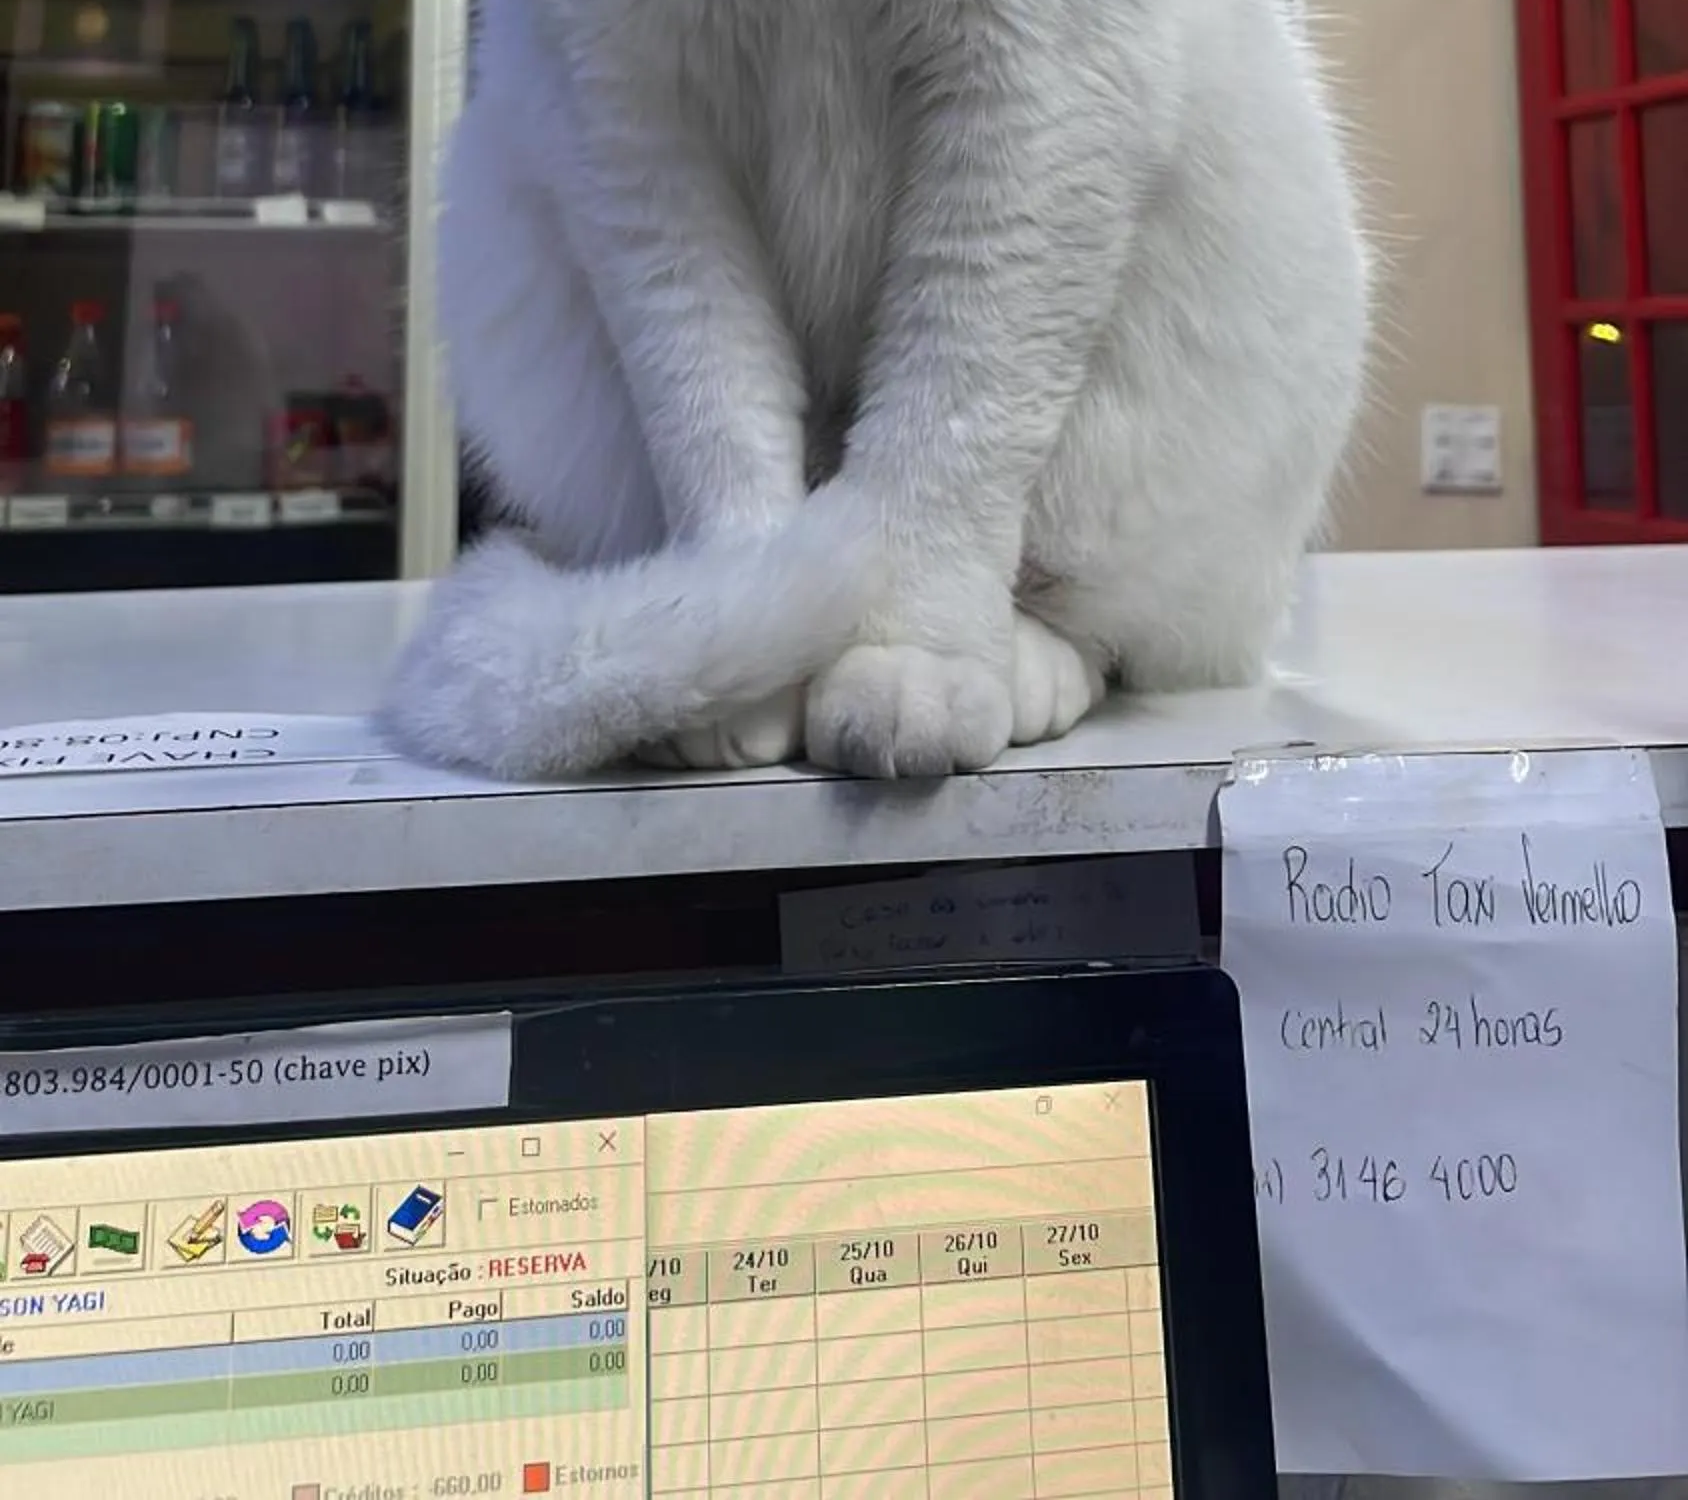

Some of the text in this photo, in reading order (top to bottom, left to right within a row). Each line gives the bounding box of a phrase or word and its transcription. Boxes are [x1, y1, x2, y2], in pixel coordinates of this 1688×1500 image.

[1284, 845, 1391, 924] Radio
[1422, 842, 1495, 926] Taxi
[5, 1048, 431, 1097] 803.984/0001-50 (chave pix)
[1311, 1147, 1406, 1202] 3146
[1430, 1153, 1518, 1201] 4000
[944, 1231, 998, 1253] 26/10
[1047, 1223, 1099, 1244] 27/10
[733, 1248, 788, 1271] 24/10
[840, 1240, 894, 1262] 25/10
[1059, 1249, 1092, 1267] Sex
[385, 1264, 471, 1287] Situação
[488, 1252, 587, 1278] RESERVA
[850, 1266, 887, 1286] Qua
[957, 1256, 988, 1276] Qui
[748, 1275, 777, 1293] Ter
[53, 1290, 105, 1313] YAGI
[571, 1289, 625, 1309] Saldo
[320, 1309, 372, 1330] Total
[449, 1300, 499, 1321] Pago
